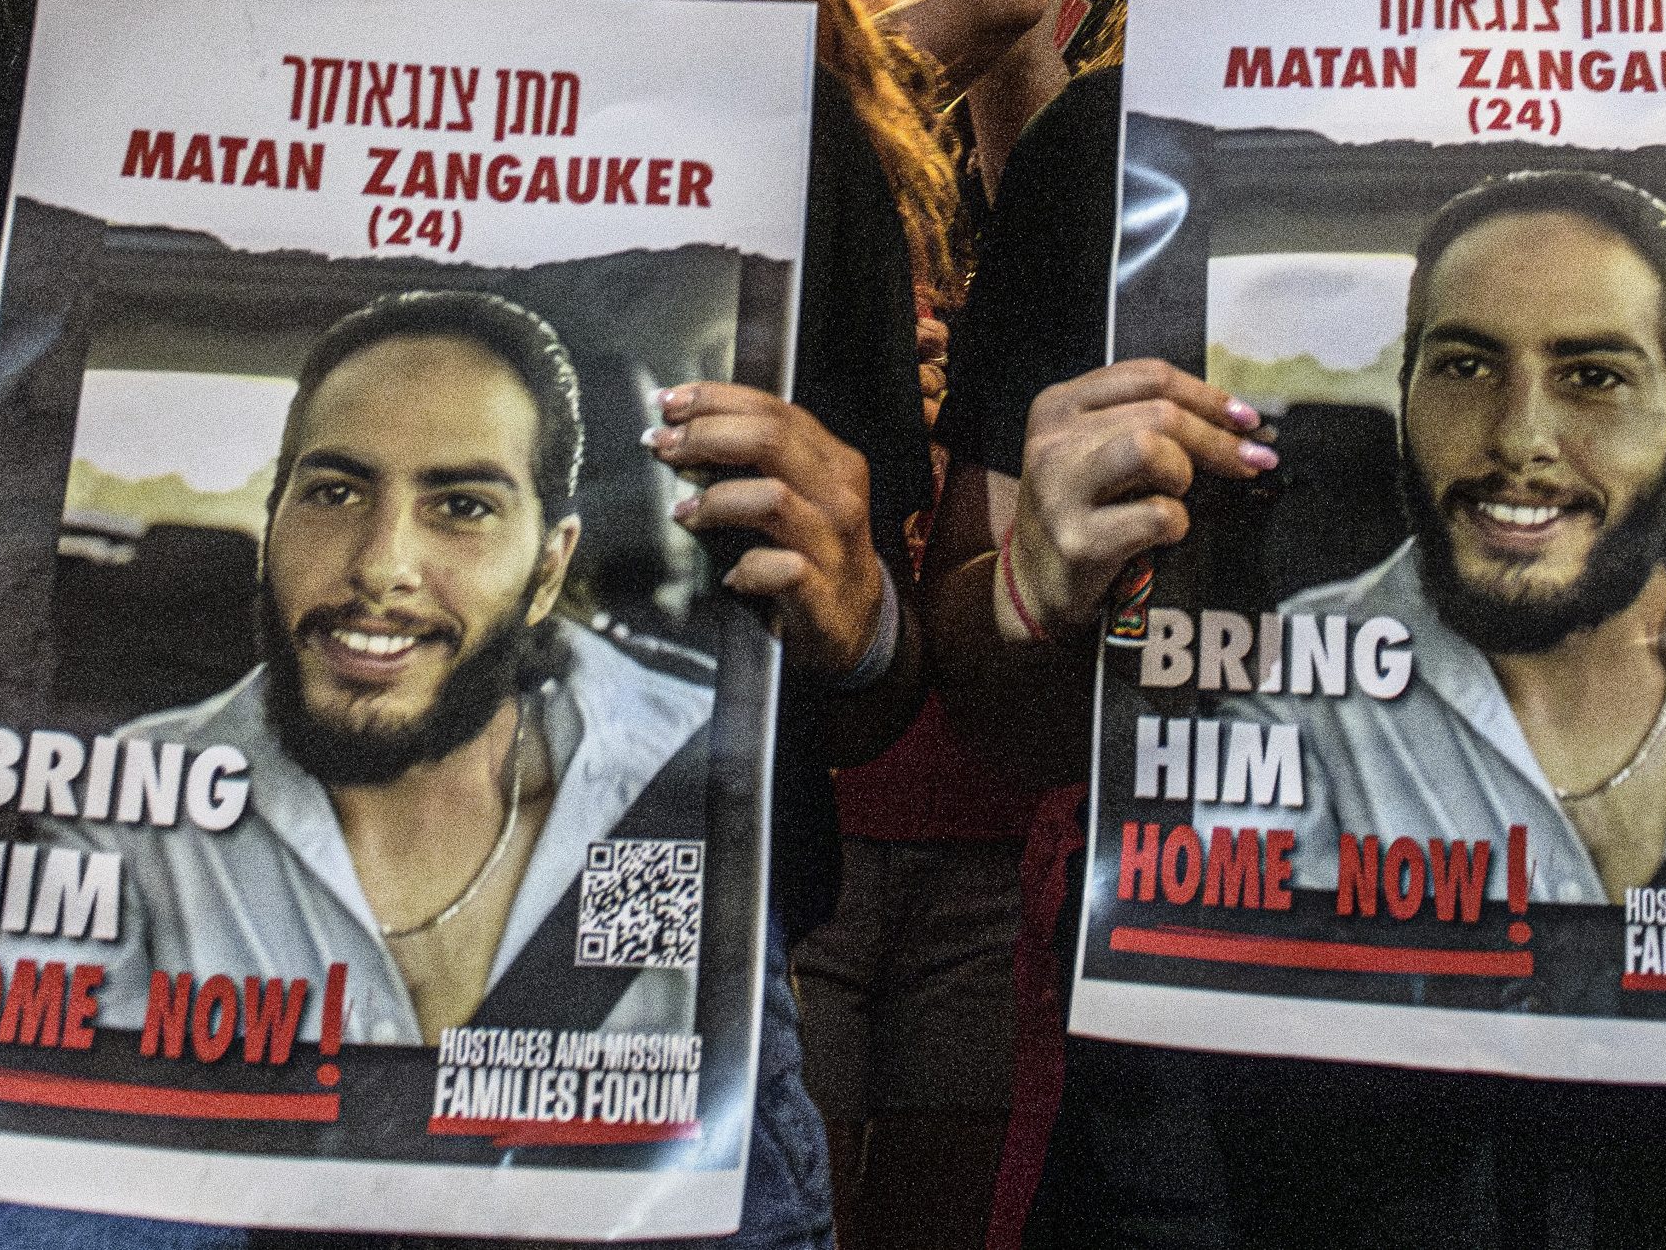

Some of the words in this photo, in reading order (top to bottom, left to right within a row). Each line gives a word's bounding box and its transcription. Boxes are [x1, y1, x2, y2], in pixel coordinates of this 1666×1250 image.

[282, 55, 480, 133] צנגאוקר
[1223, 46, 1417, 88] MATAN
[494, 68, 581, 142] מתן
[1468, 97, 1562, 137] (24)
[121, 129, 326, 192] MATAN
[362, 146, 714, 208] ZANGAUKER
[368, 205, 464, 252] (24)
[1140, 608, 1413, 701] BRING
[1134, 716, 1304, 808] HIM
[1117, 821, 1296, 911] HOME
[438, 1027, 552, 1068] HOSTAGES
[553, 1031, 600, 1069] AND
[602, 1032, 703, 1072] MISSING
[434, 1067, 580, 1122] FAMILIES
[583, 1070, 700, 1124] FORUM
